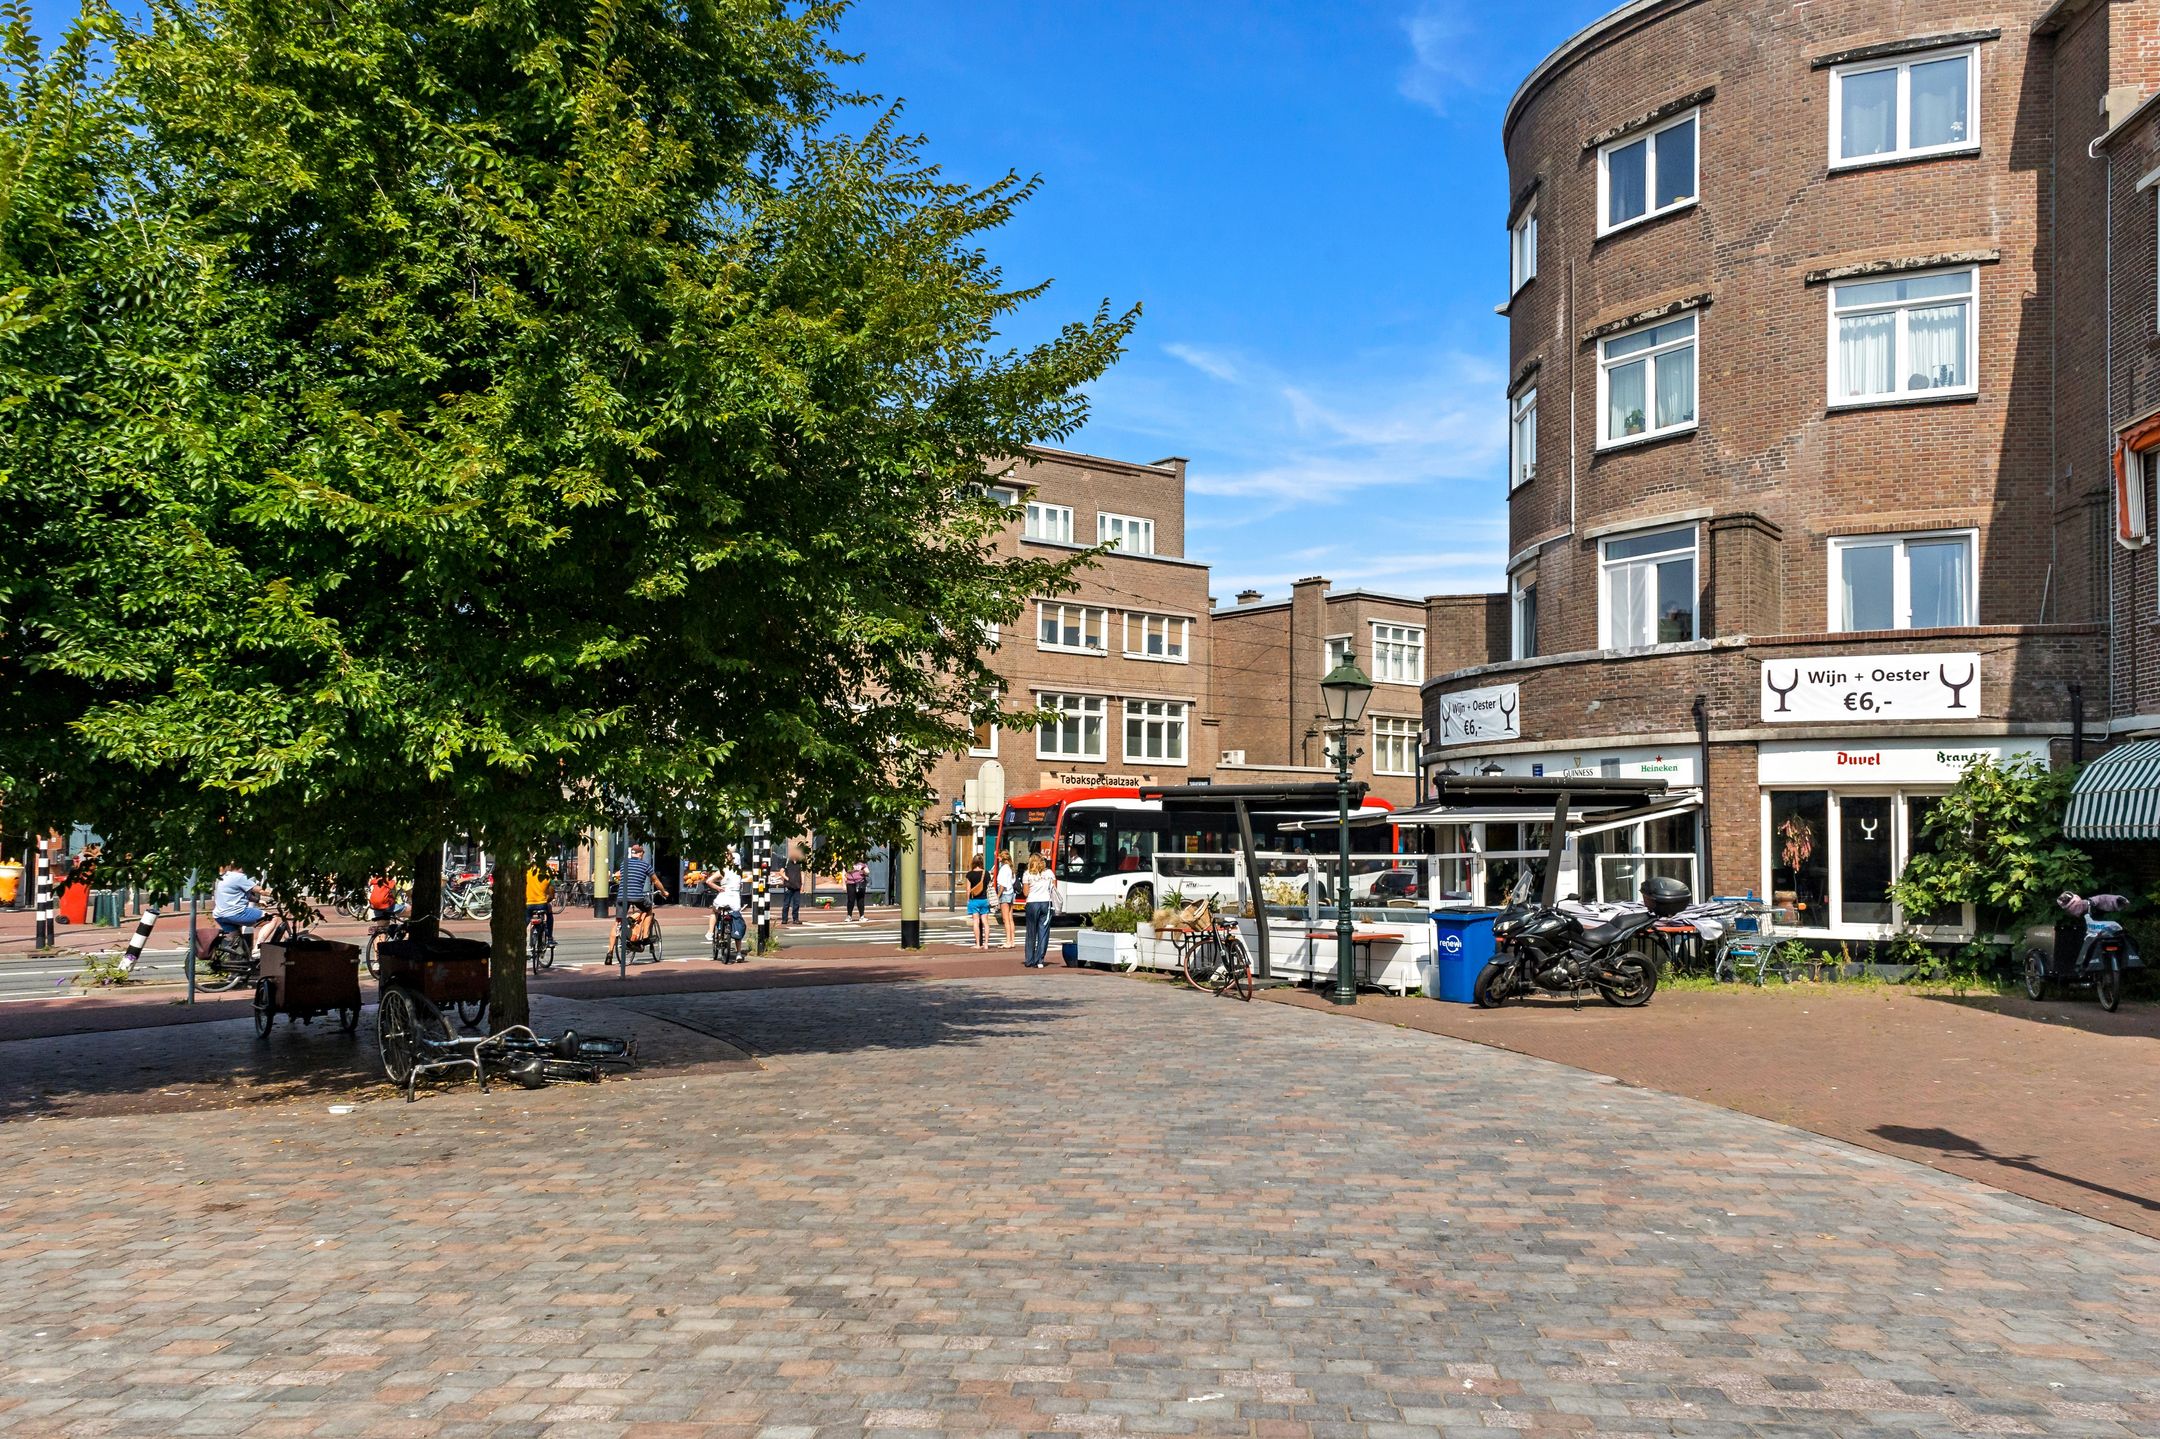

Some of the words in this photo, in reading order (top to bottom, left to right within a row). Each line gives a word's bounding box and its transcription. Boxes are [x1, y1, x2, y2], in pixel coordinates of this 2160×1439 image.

[1808, 670, 1847, 687] Wijn
[1854, 673, 1864, 682] +
[1871, 668, 1930, 682] Oester
[1452, 703, 1466, 716] Wijn
[1472, 700, 1496, 711] Oester
[1843, 691, 1892, 713] €6,-
[1464, 719, 1482, 736] €6,-
[1837, 751, 1880, 765] Duvel
[1563, 768, 1594, 777] GUINNESS
[1641, 764, 1678, 772] Heineken
[1060, 775, 1140, 787] Tabakspeciaalzaak
